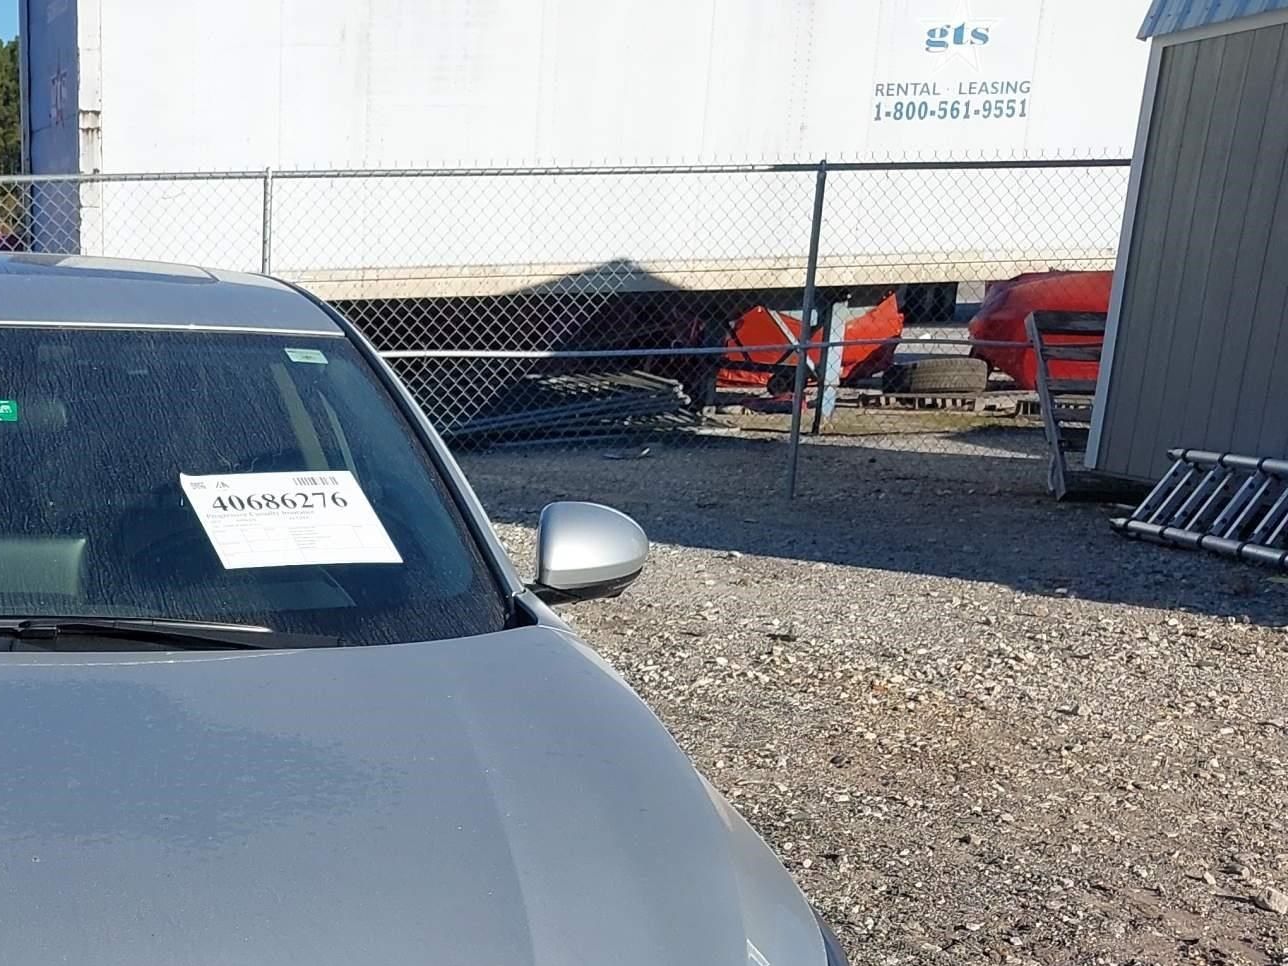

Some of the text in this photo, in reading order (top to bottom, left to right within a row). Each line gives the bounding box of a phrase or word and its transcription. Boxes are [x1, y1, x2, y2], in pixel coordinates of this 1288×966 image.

[925, 22, 990, 53] gts
[874, 83, 941, 97] RENTAL
[958, 80, 1032, 96] LEASING
[874, 98, 1028, 121] 1-800-561-9551
[212, 491, 348, 512] 40686276
